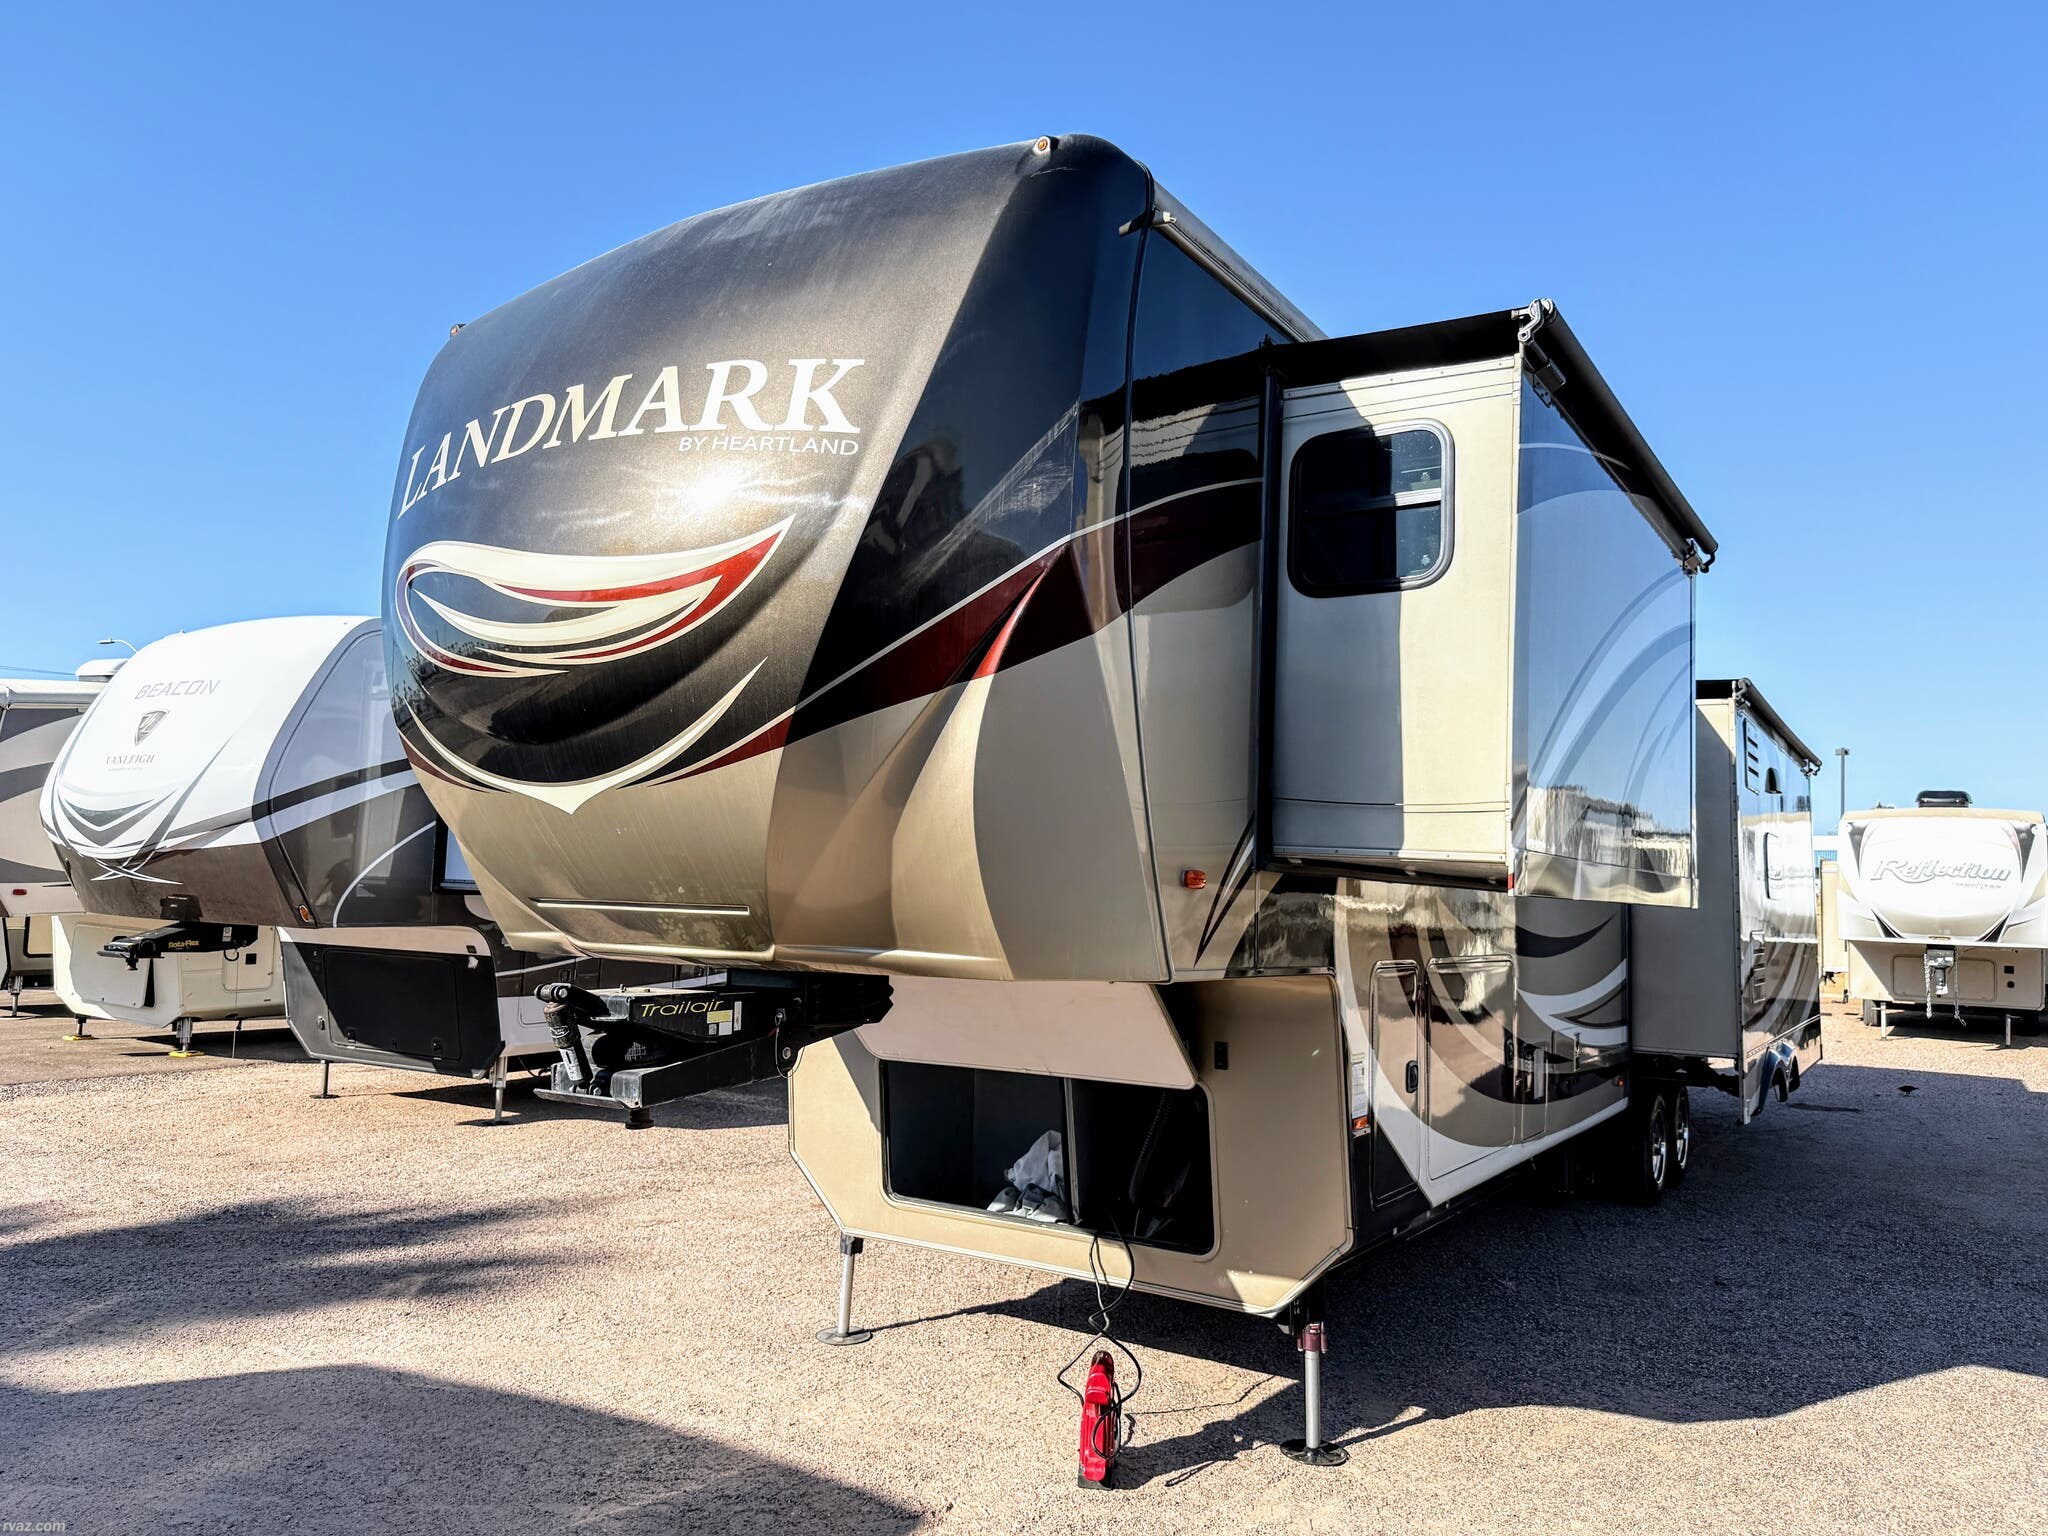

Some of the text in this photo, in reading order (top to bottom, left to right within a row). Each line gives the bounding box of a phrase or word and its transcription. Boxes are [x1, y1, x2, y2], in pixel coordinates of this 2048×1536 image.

[397, 358, 866, 520] LANDMARK
[679, 436, 859, 456] BY HEARTLAND
[134, 680, 221, 700] BEACON
[1870, 860, 2011, 883] Reflection
[641, 999, 724, 1018] Trailair
